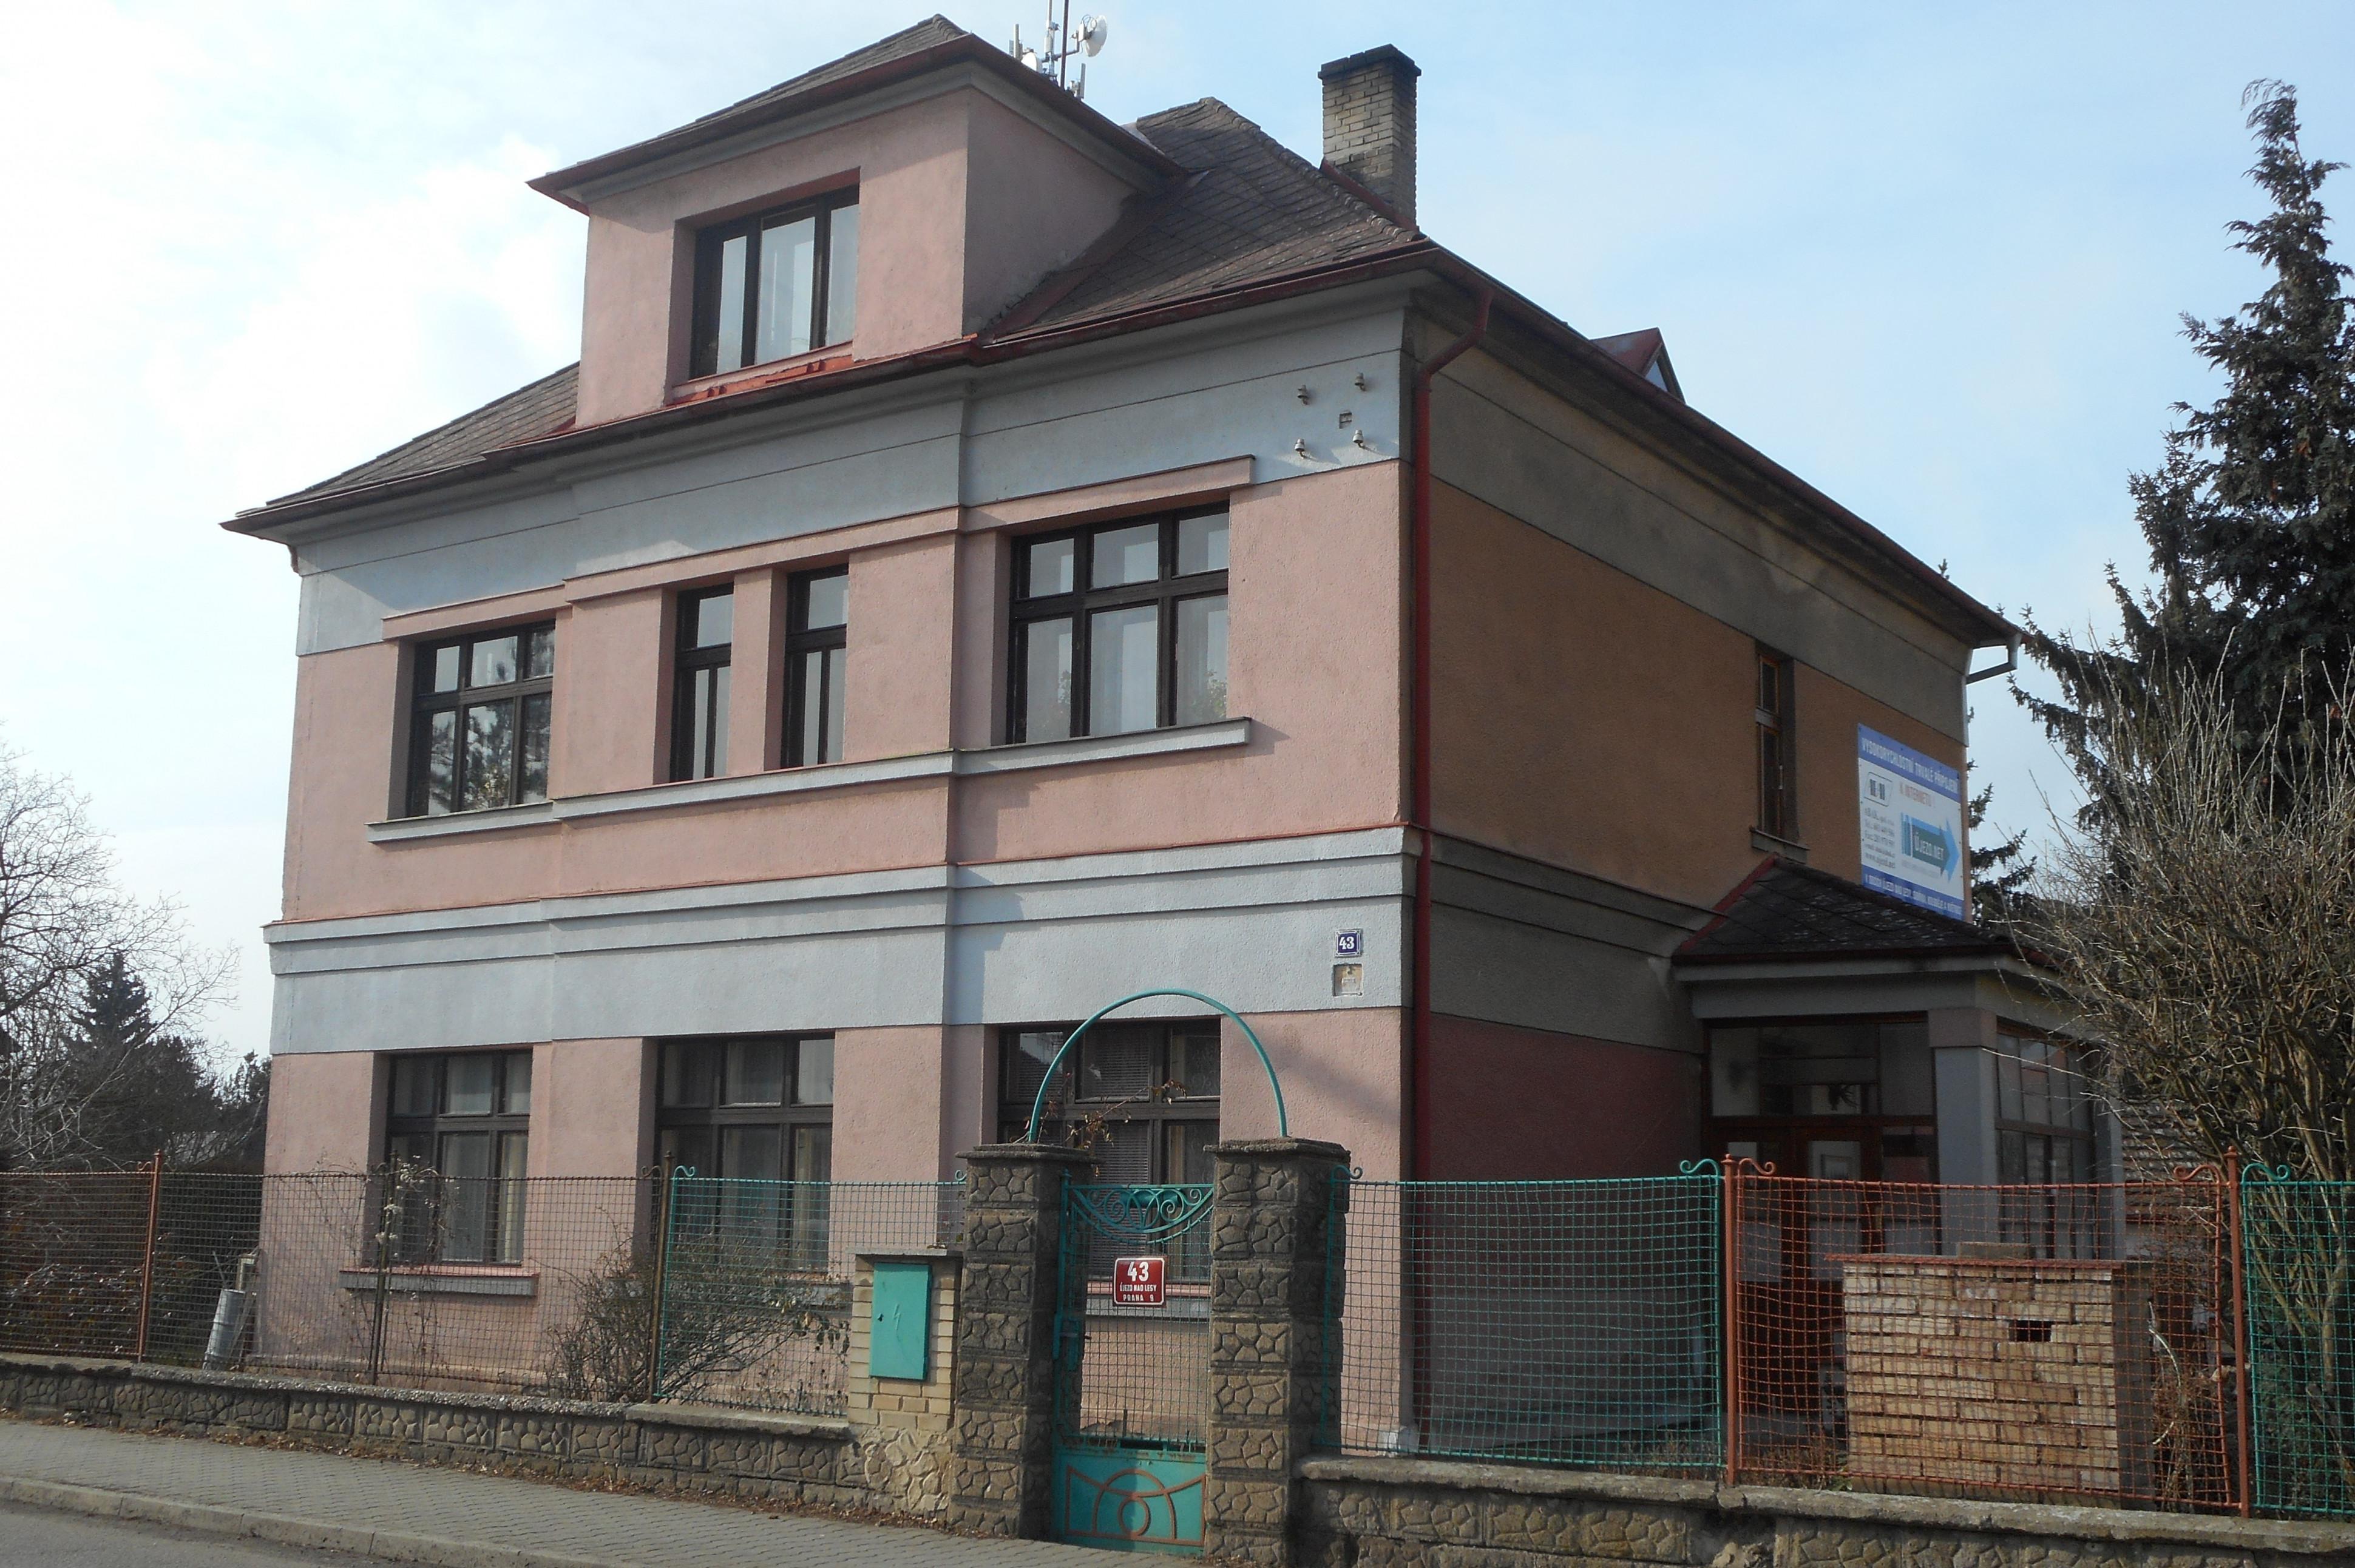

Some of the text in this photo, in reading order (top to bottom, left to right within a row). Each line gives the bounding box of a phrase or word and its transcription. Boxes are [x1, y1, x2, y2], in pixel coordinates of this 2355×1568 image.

[1339, 936, 1354, 950] 43
[1127, 1262, 1149, 1282] 43
[1120, 1282, 1133, 1291] ÚJEZD
